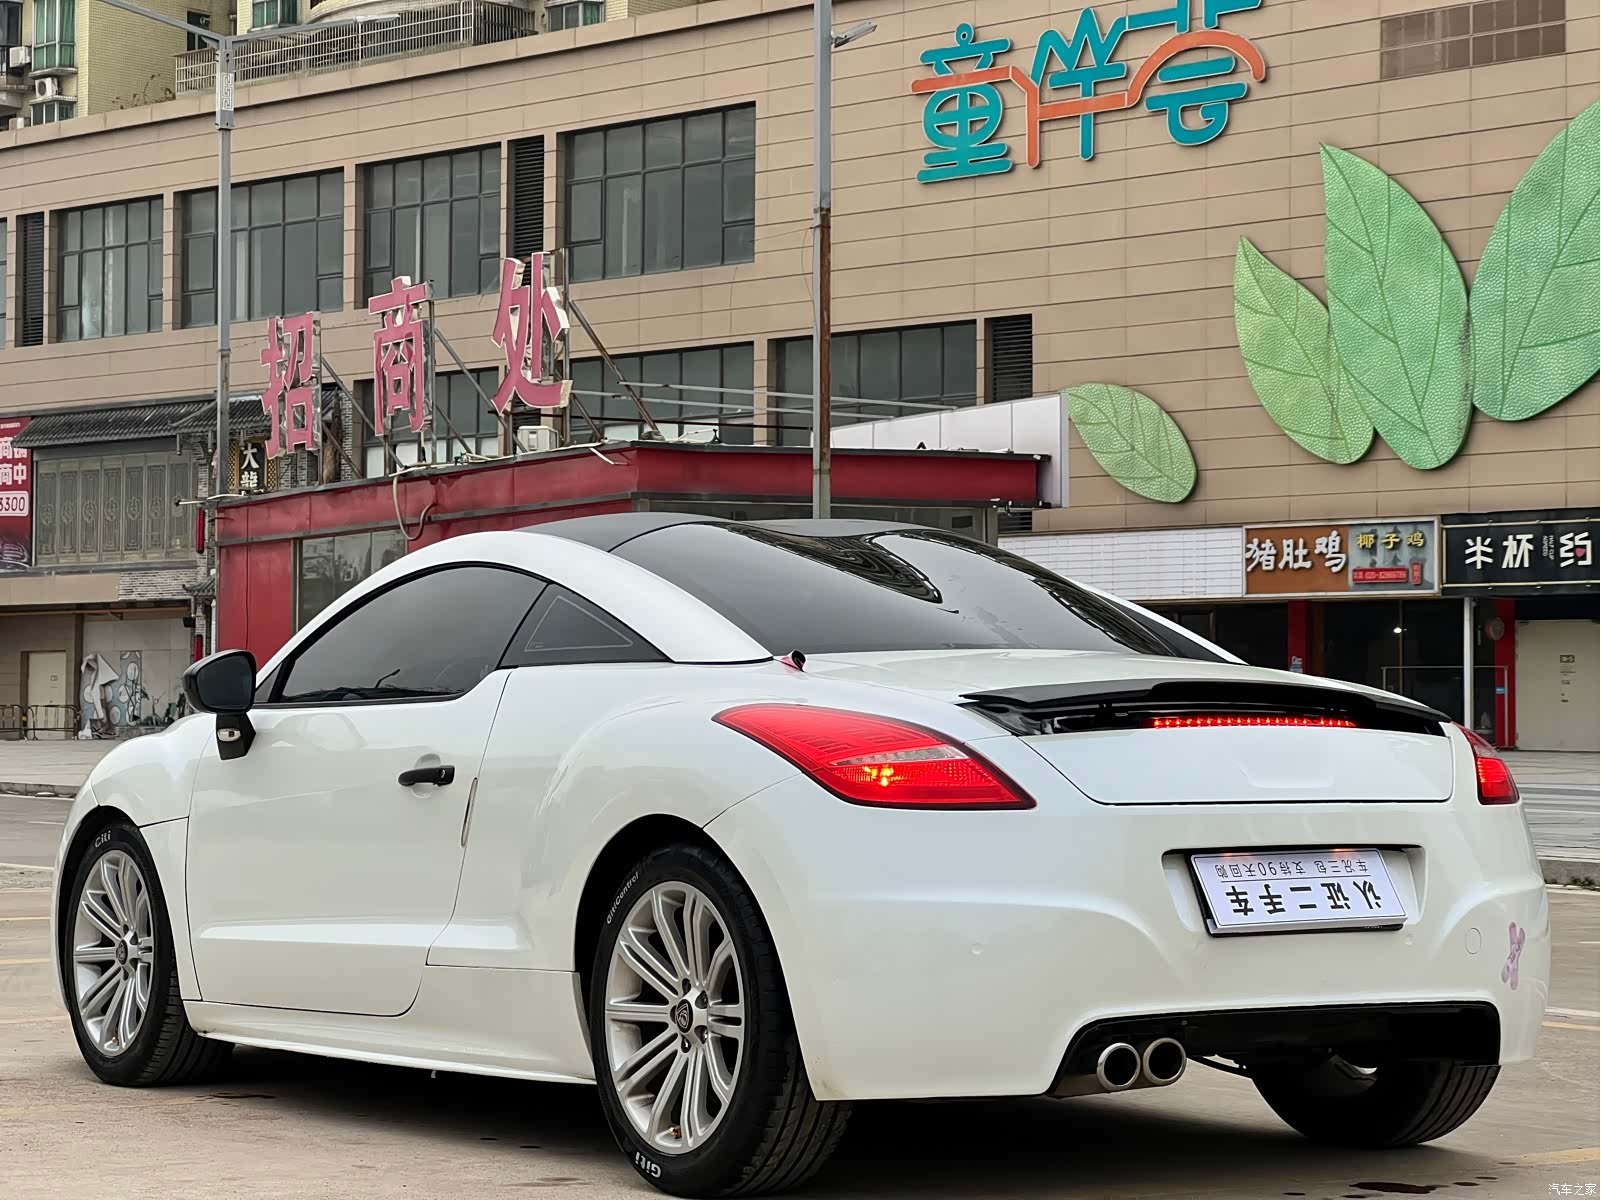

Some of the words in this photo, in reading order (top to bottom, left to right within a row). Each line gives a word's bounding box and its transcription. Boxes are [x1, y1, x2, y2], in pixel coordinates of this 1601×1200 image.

[261, 250, 572, 460] 招商处
[1245, 530, 1346, 573] 猪肚鸡
[1356, 530, 1425, 549] 椰子鸡
[1215, 860, 1305, 878] 支持90天回购
[1314, 859, 1368, 874] 车况三包
[606, 871, 639, 925] GitiControl
[1226, 880, 1381, 916] 认证二手车
[635, 1151, 662, 1178] Giti
